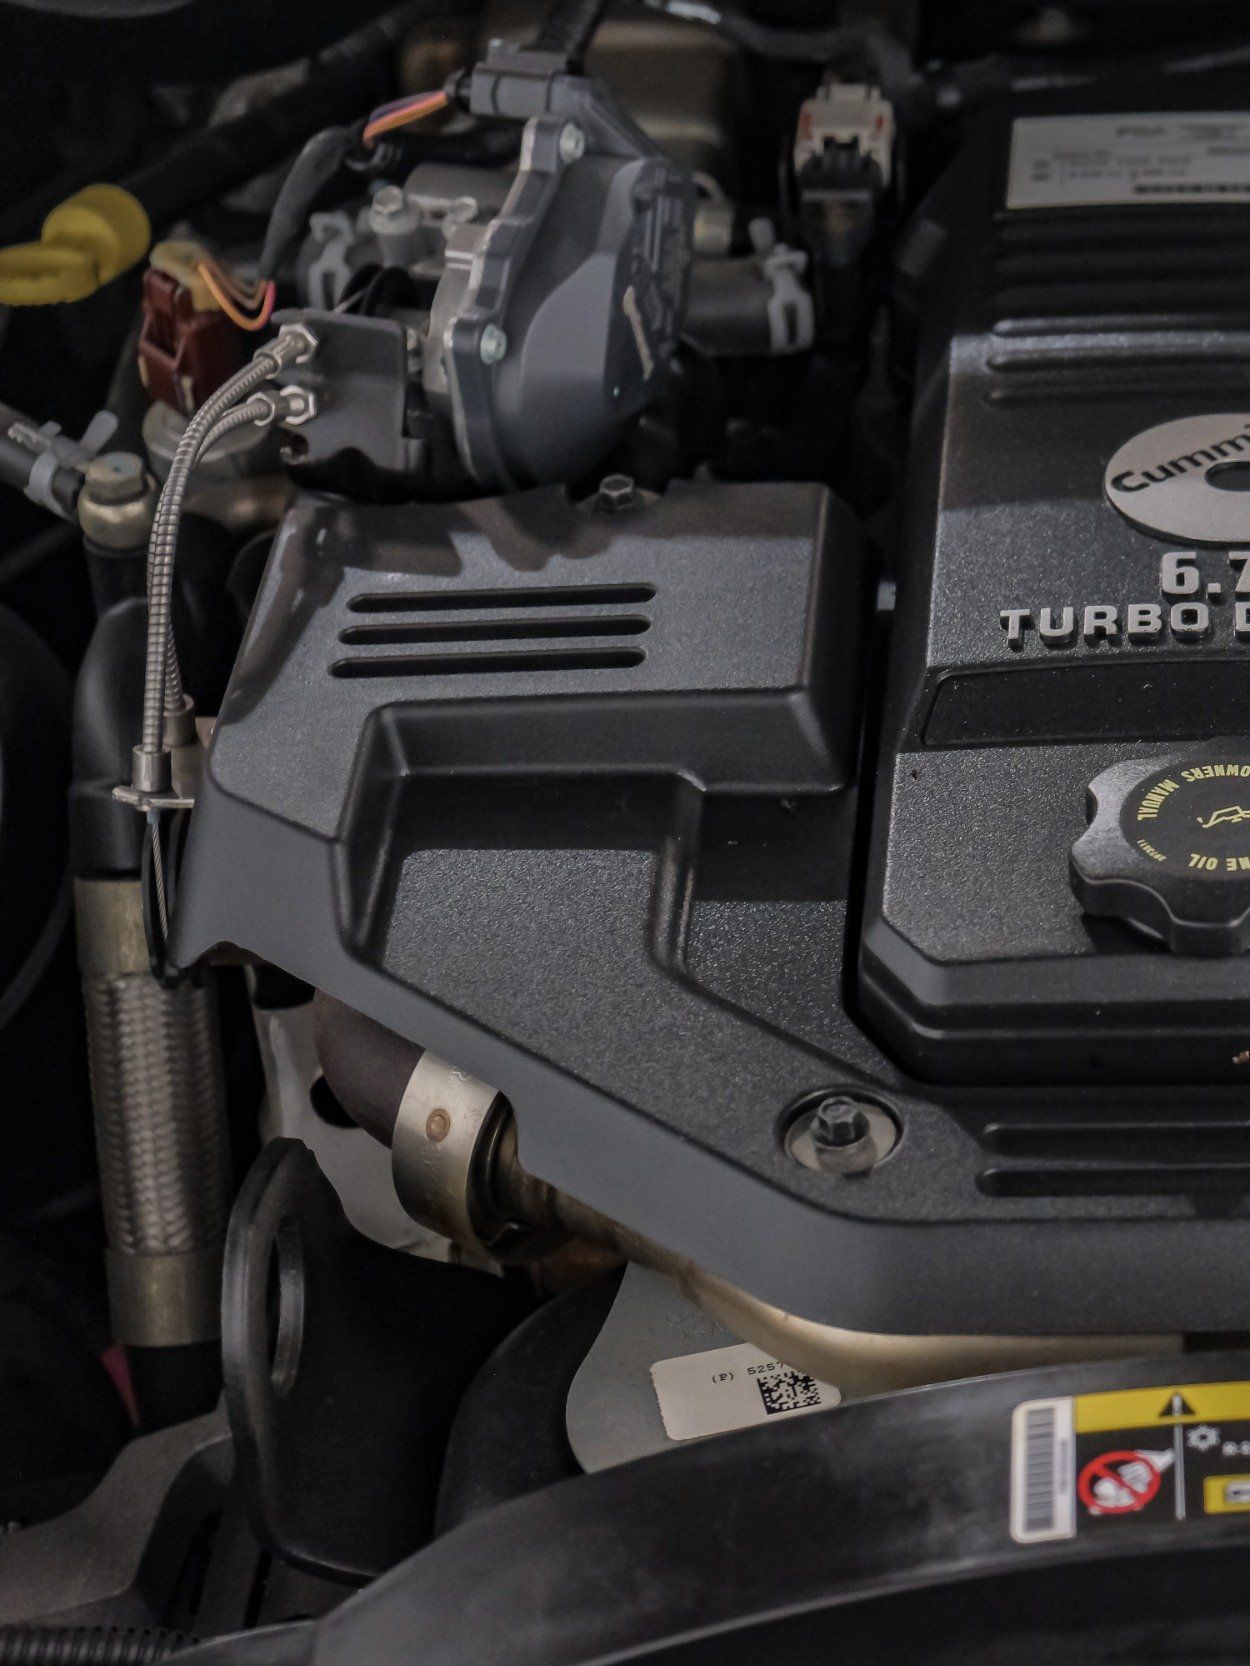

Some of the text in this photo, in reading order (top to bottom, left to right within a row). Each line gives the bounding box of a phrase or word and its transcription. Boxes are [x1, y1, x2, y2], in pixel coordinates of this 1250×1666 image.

[1000, 601, 1210, 644] TURBO
[1137, 779, 1181, 821] MANUAL
[1187, 853, 1219, 871] OIL
